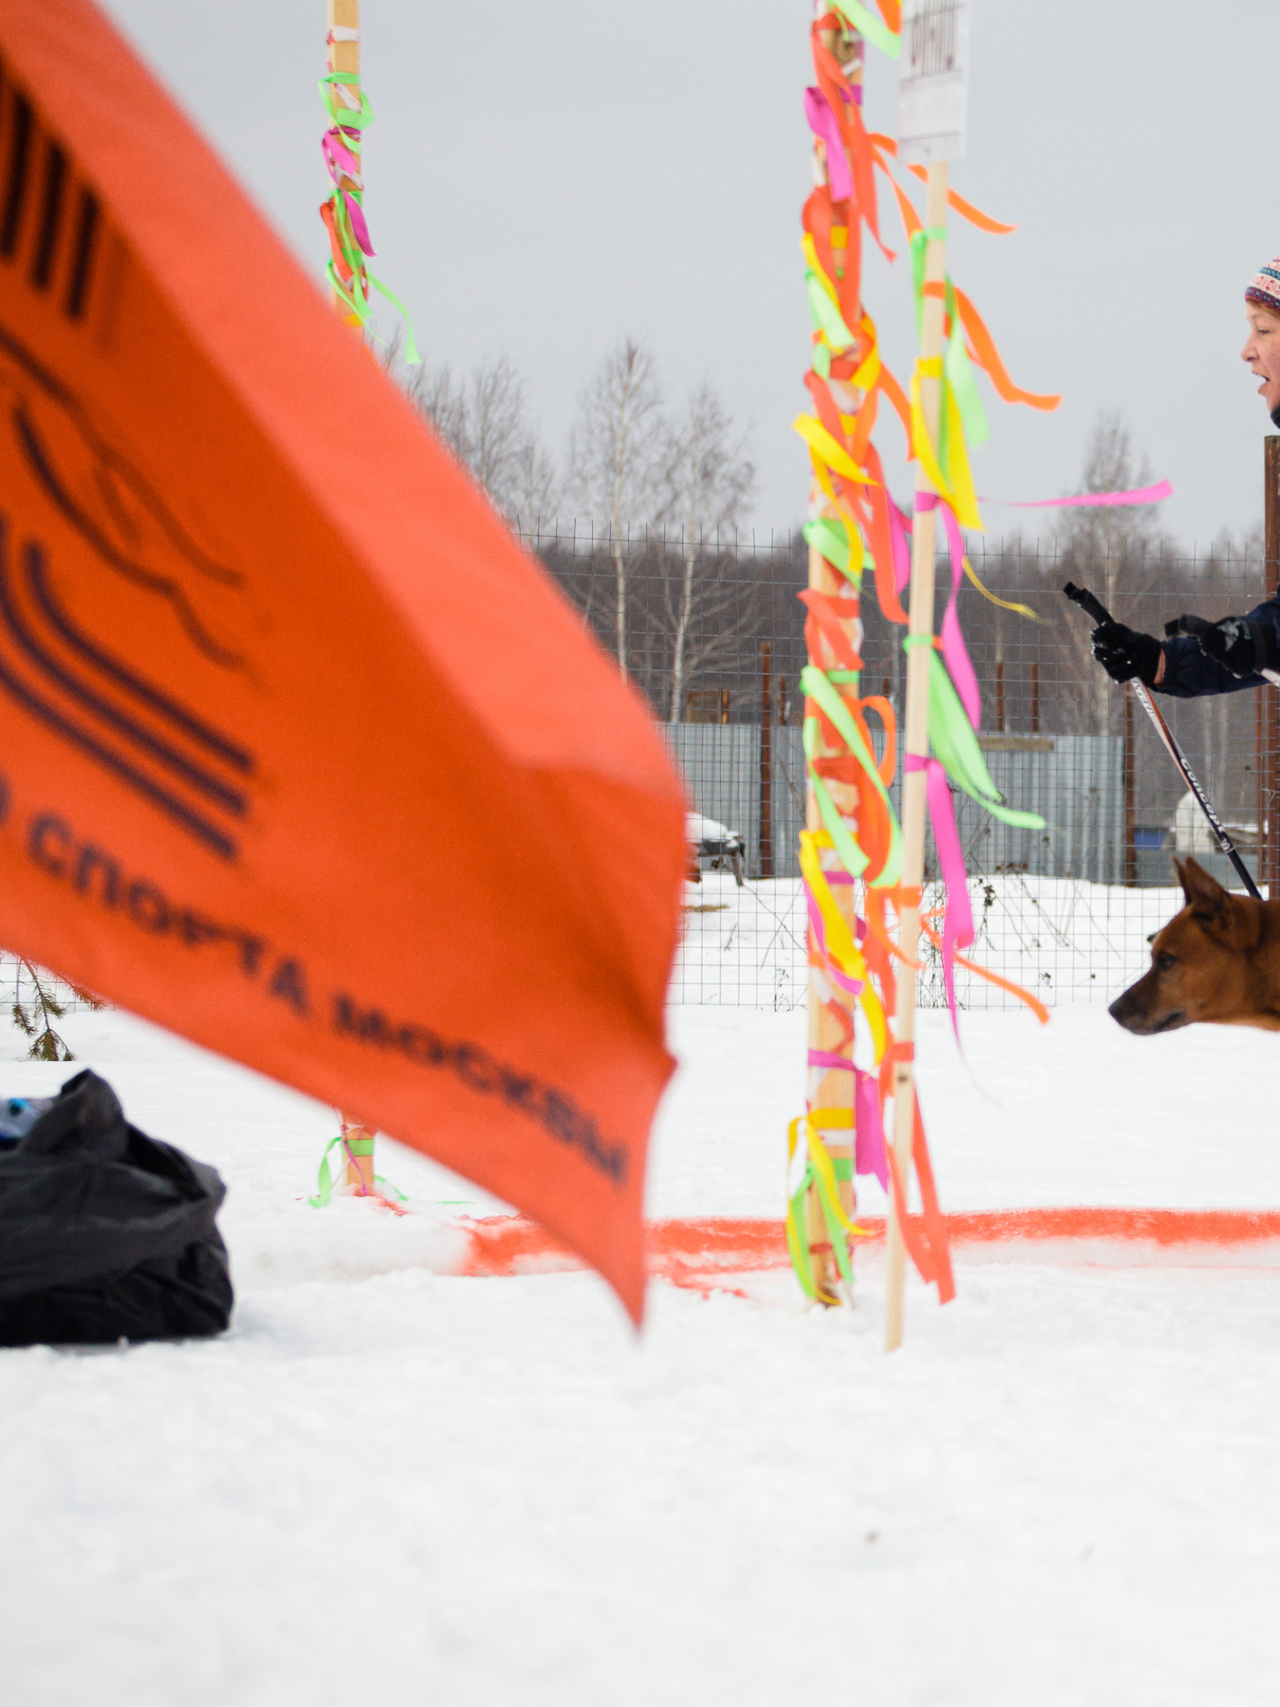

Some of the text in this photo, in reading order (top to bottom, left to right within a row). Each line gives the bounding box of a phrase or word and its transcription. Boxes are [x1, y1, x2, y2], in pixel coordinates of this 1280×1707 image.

[1180, 757, 1227, 835] Concept
[26, 811, 631, 1190] СПОРТА МОСКВЫ
